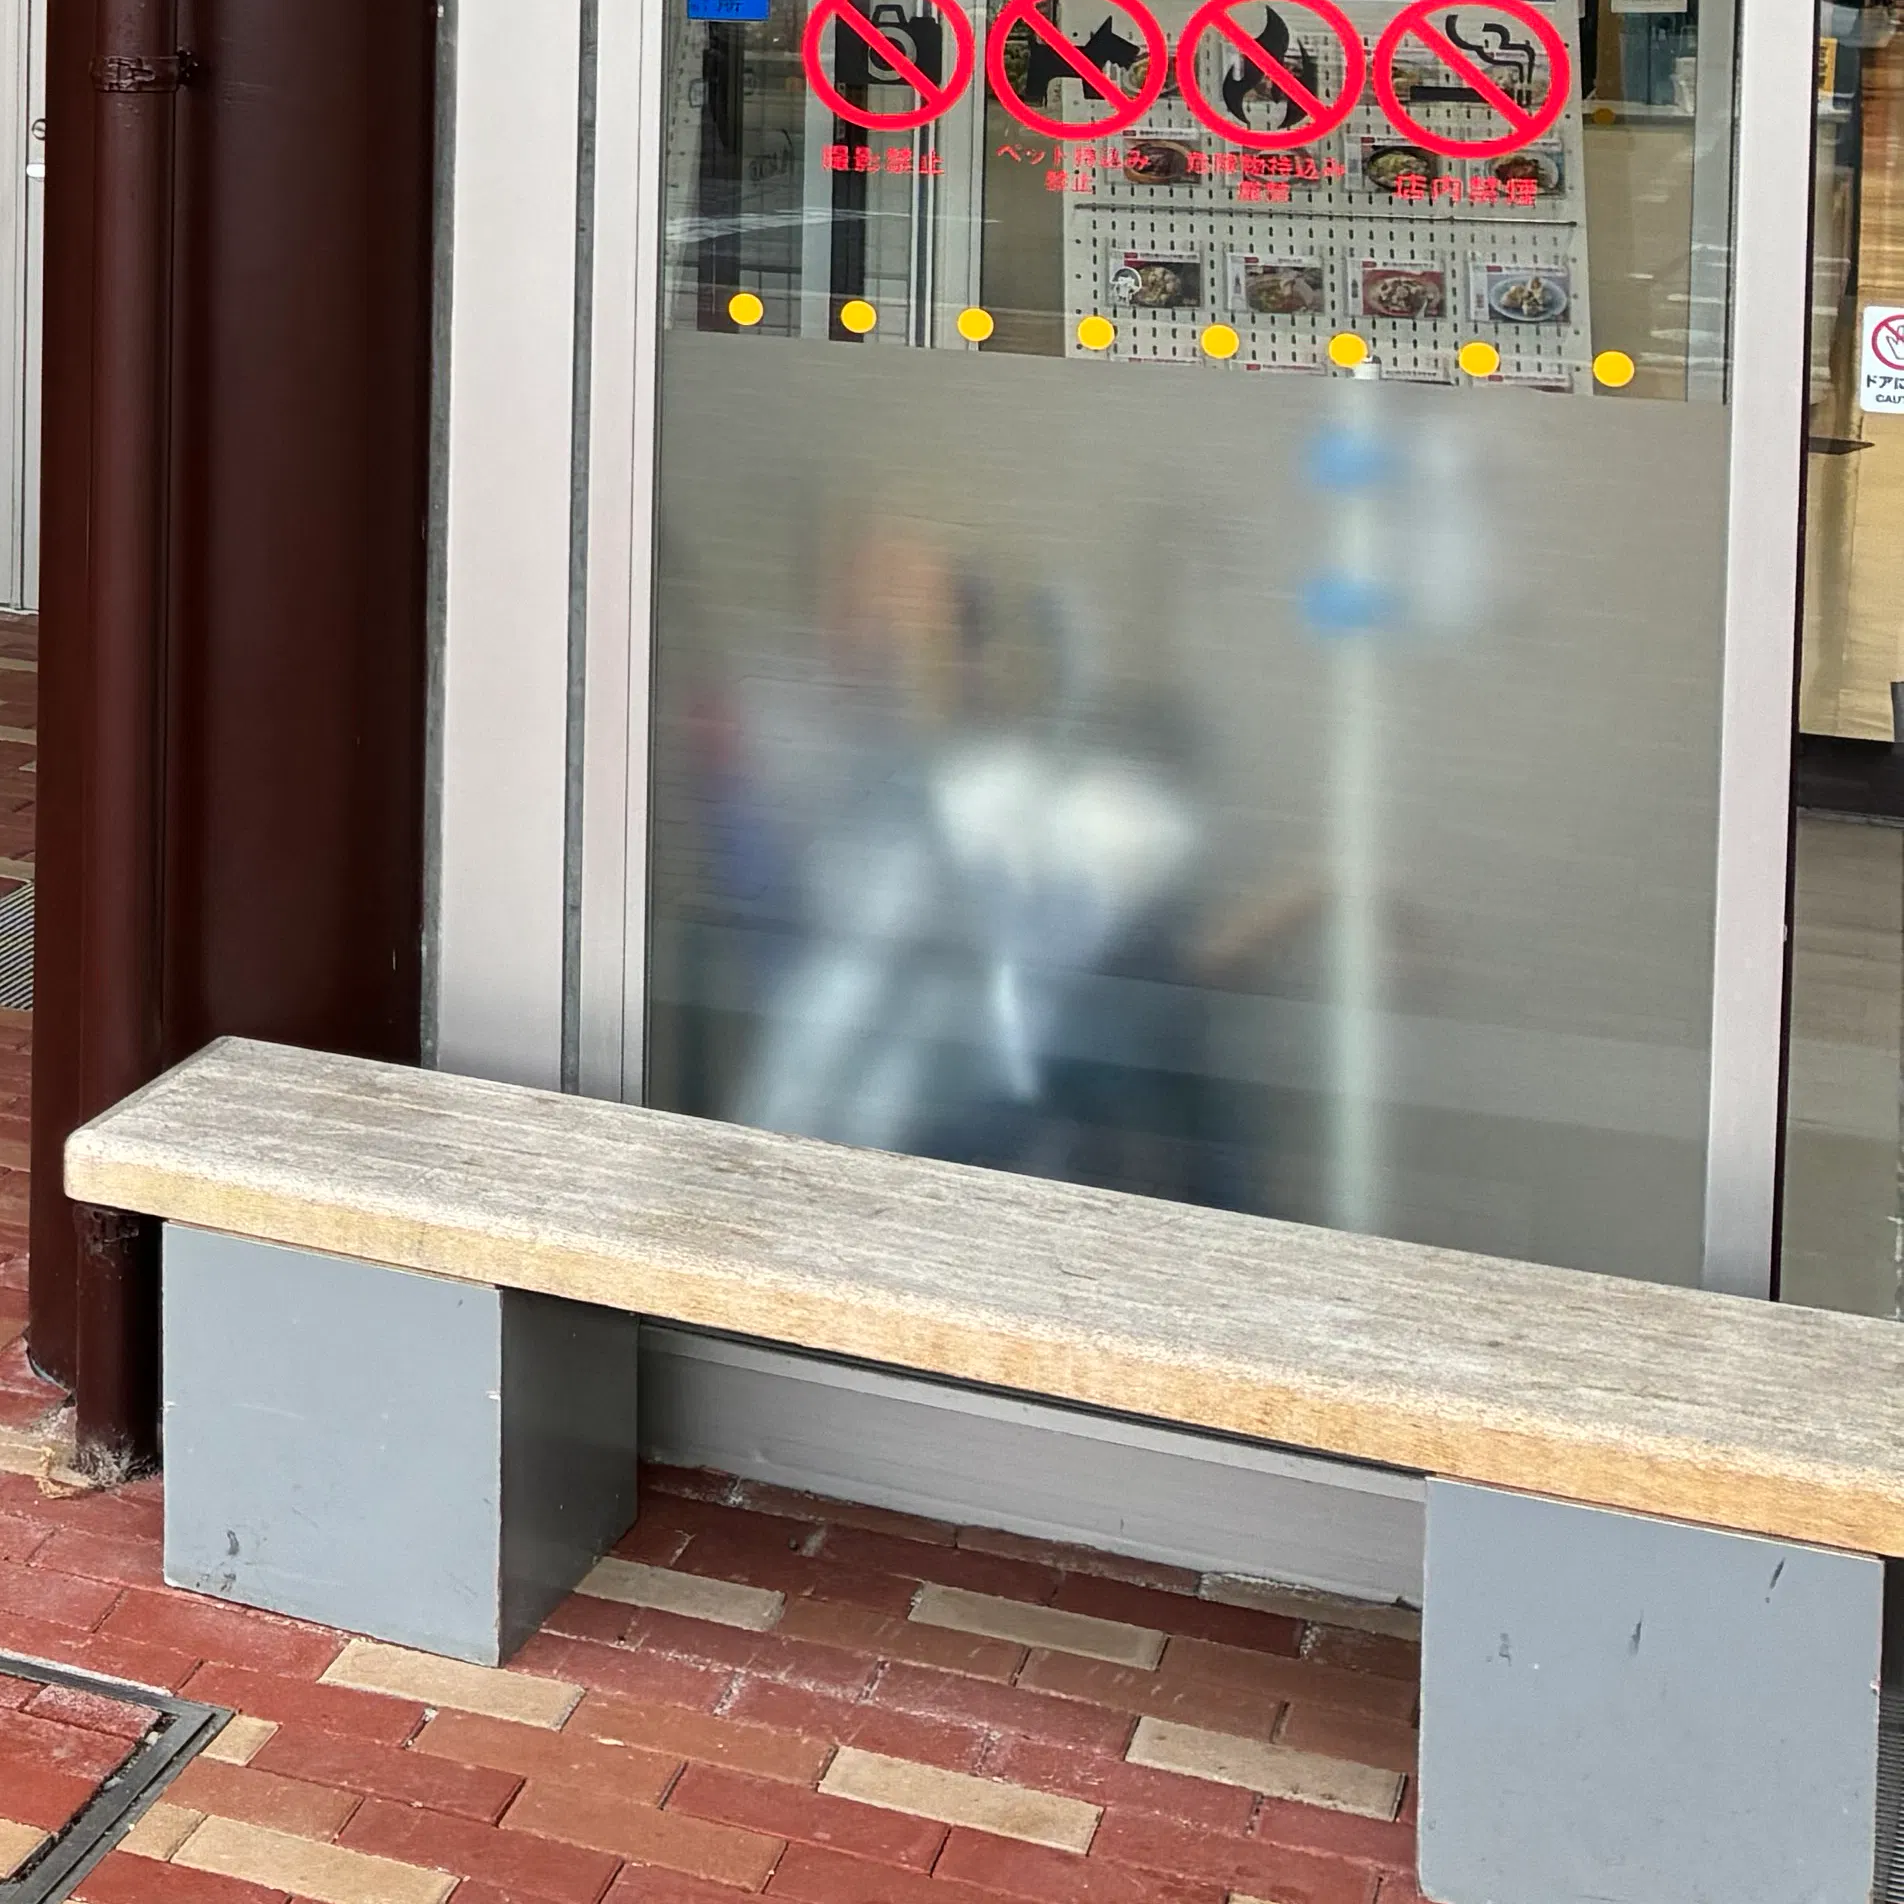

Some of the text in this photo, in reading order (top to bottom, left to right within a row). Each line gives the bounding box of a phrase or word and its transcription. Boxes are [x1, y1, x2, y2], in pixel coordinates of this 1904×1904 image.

[821, 144, 944, 175] 撮影禁止
[996, 144, 1151, 170] ペット持込み
[1045, 170, 1093, 192] 禁止
[1392, 174, 1538, 206] 店内禁煙
